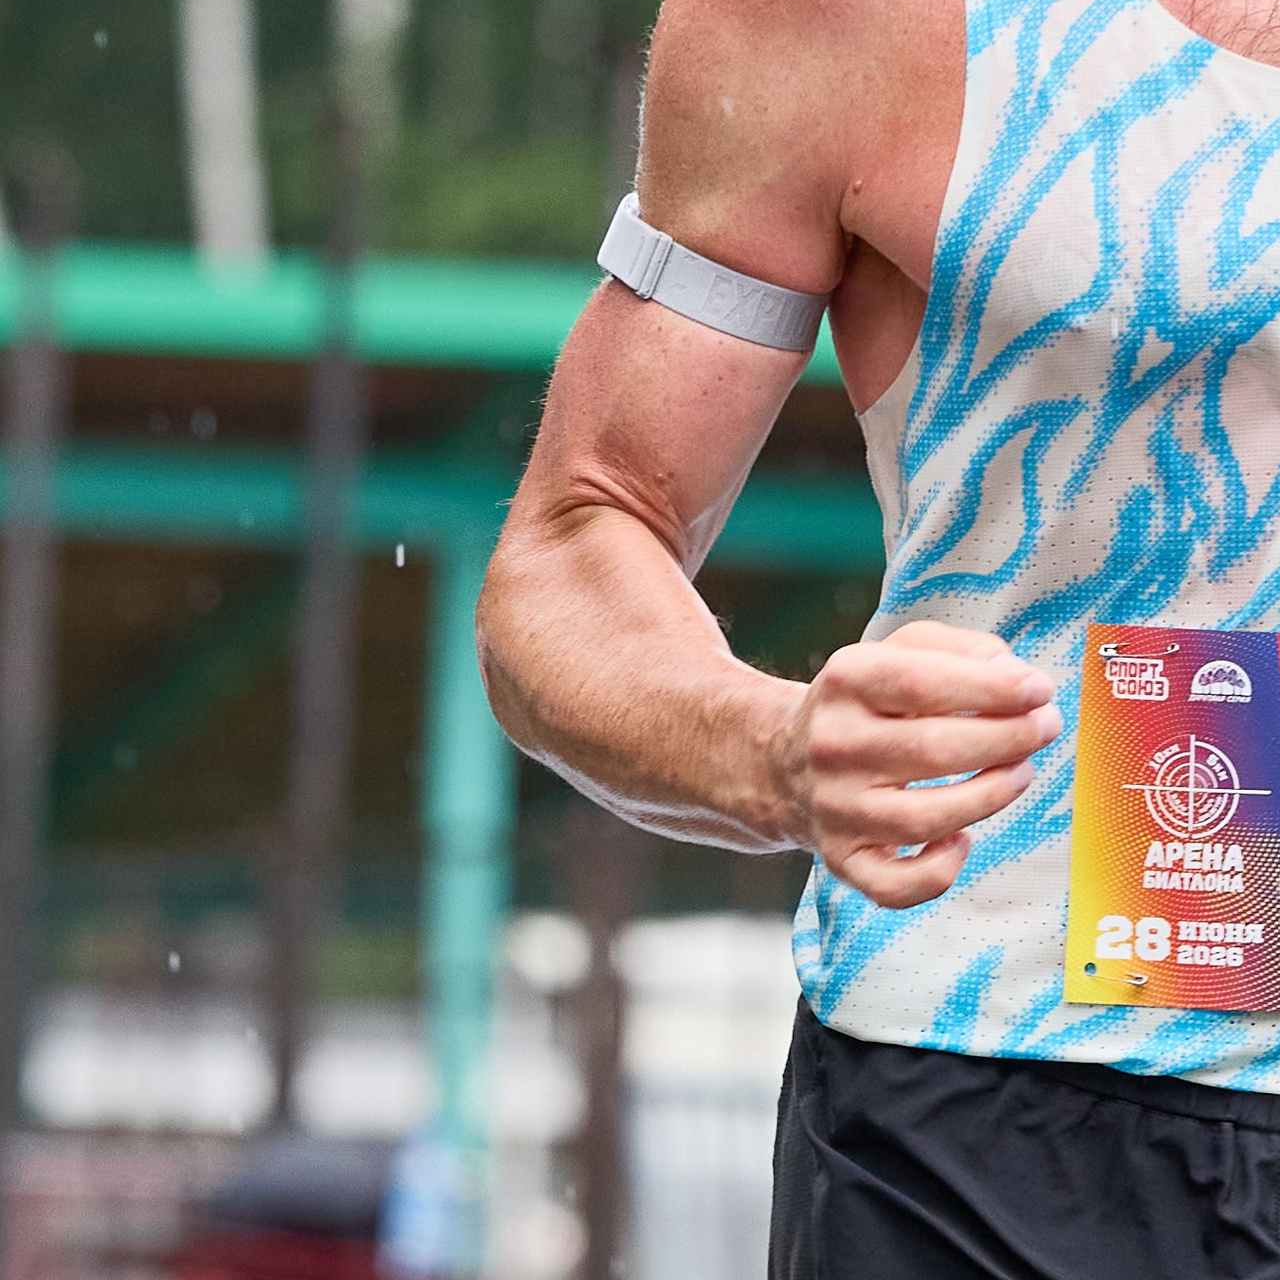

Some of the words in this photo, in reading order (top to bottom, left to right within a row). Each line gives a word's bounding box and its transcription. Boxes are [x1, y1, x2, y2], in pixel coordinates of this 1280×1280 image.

[1109, 661, 1160, 679] СПОРТ
[1116, 679, 1165, 696] СОЮЗ
[1144, 841, 1244, 871] АРЕНА
[1142, 870, 1245, 893] БИАТЛОНА
[1095, 915, 1172, 961] 28
[1177, 921, 1265, 943] ИЮНЯ
[1176, 945, 1244, 967] 2026
